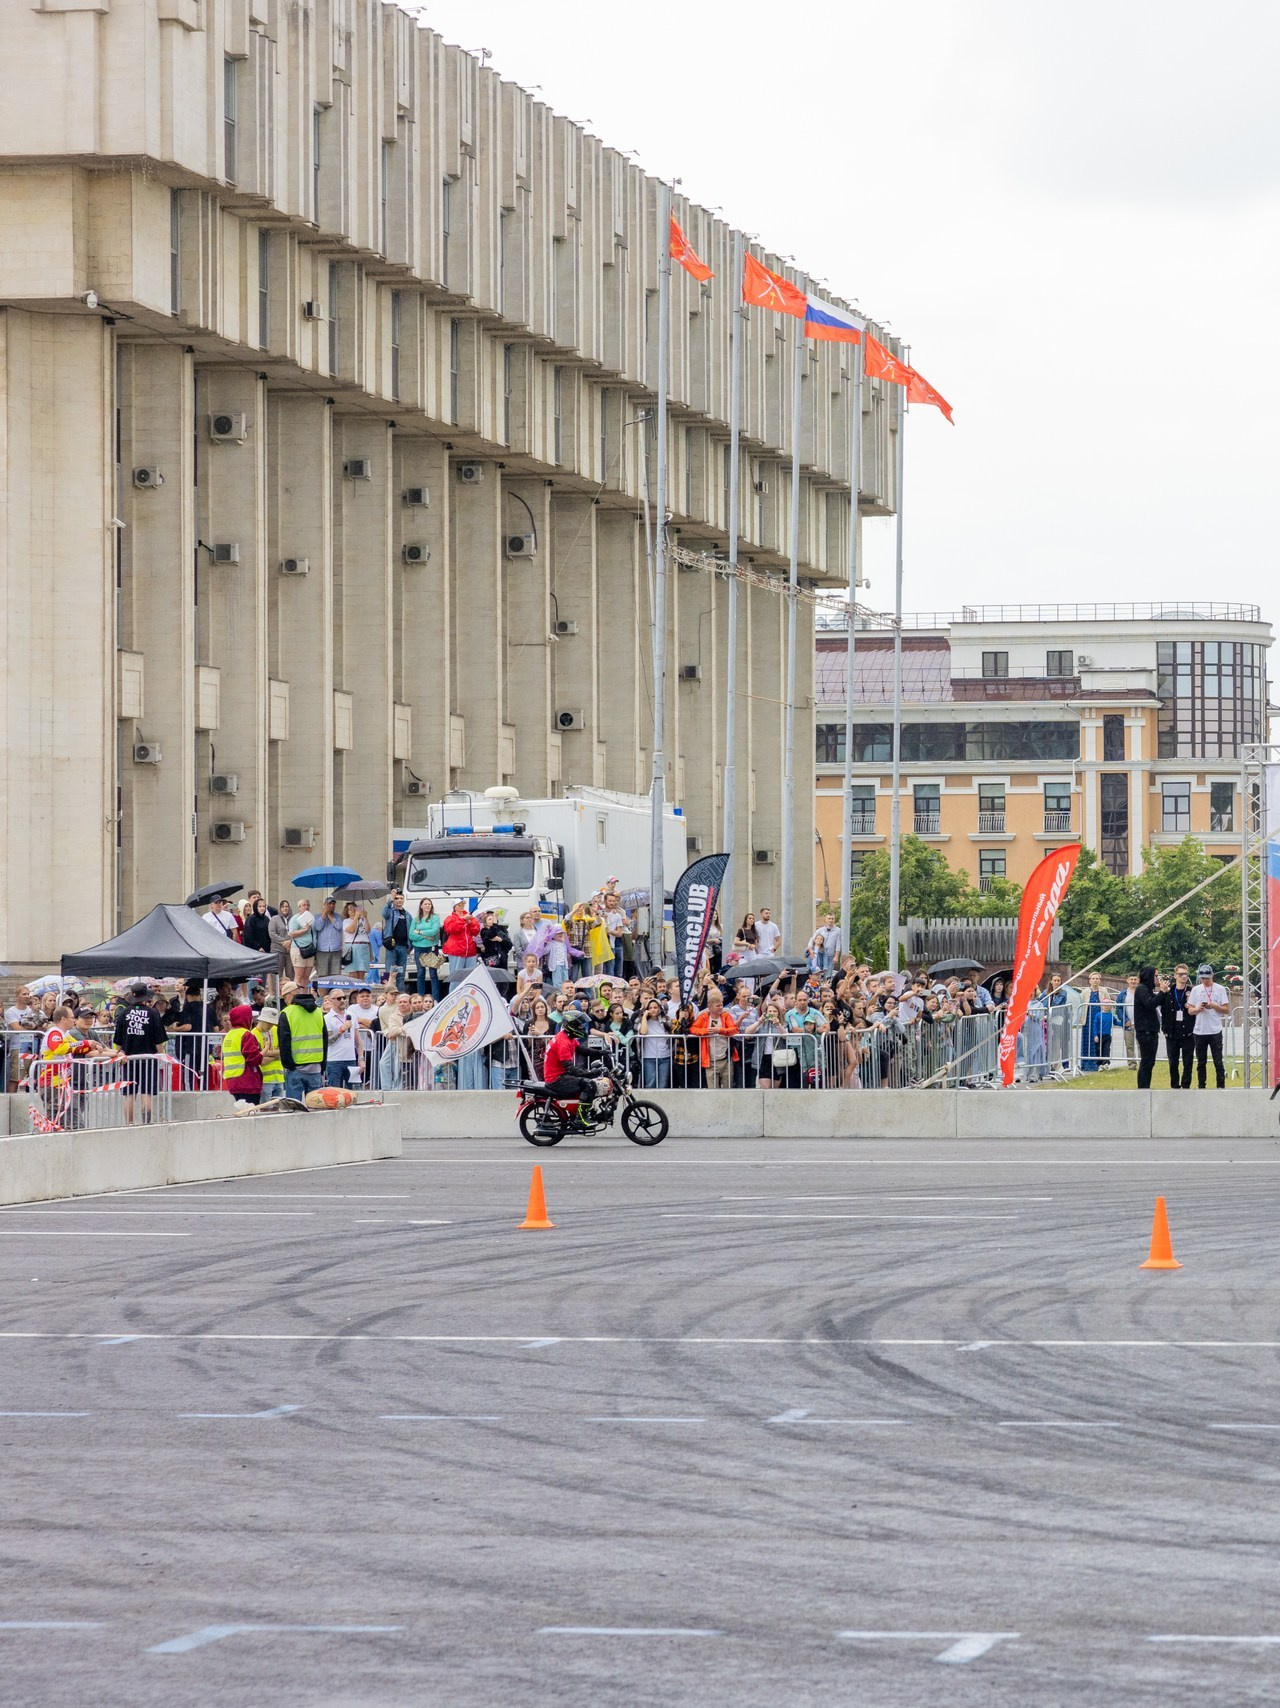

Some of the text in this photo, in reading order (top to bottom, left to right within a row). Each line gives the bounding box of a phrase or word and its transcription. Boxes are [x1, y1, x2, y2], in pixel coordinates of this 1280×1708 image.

[130, 1009, 148, 1017] ANTI
[125, 1014, 150, 1024] STOCK
[129, 1020, 143, 1029] CAR
[126, 1027, 145, 1035] CLUB
